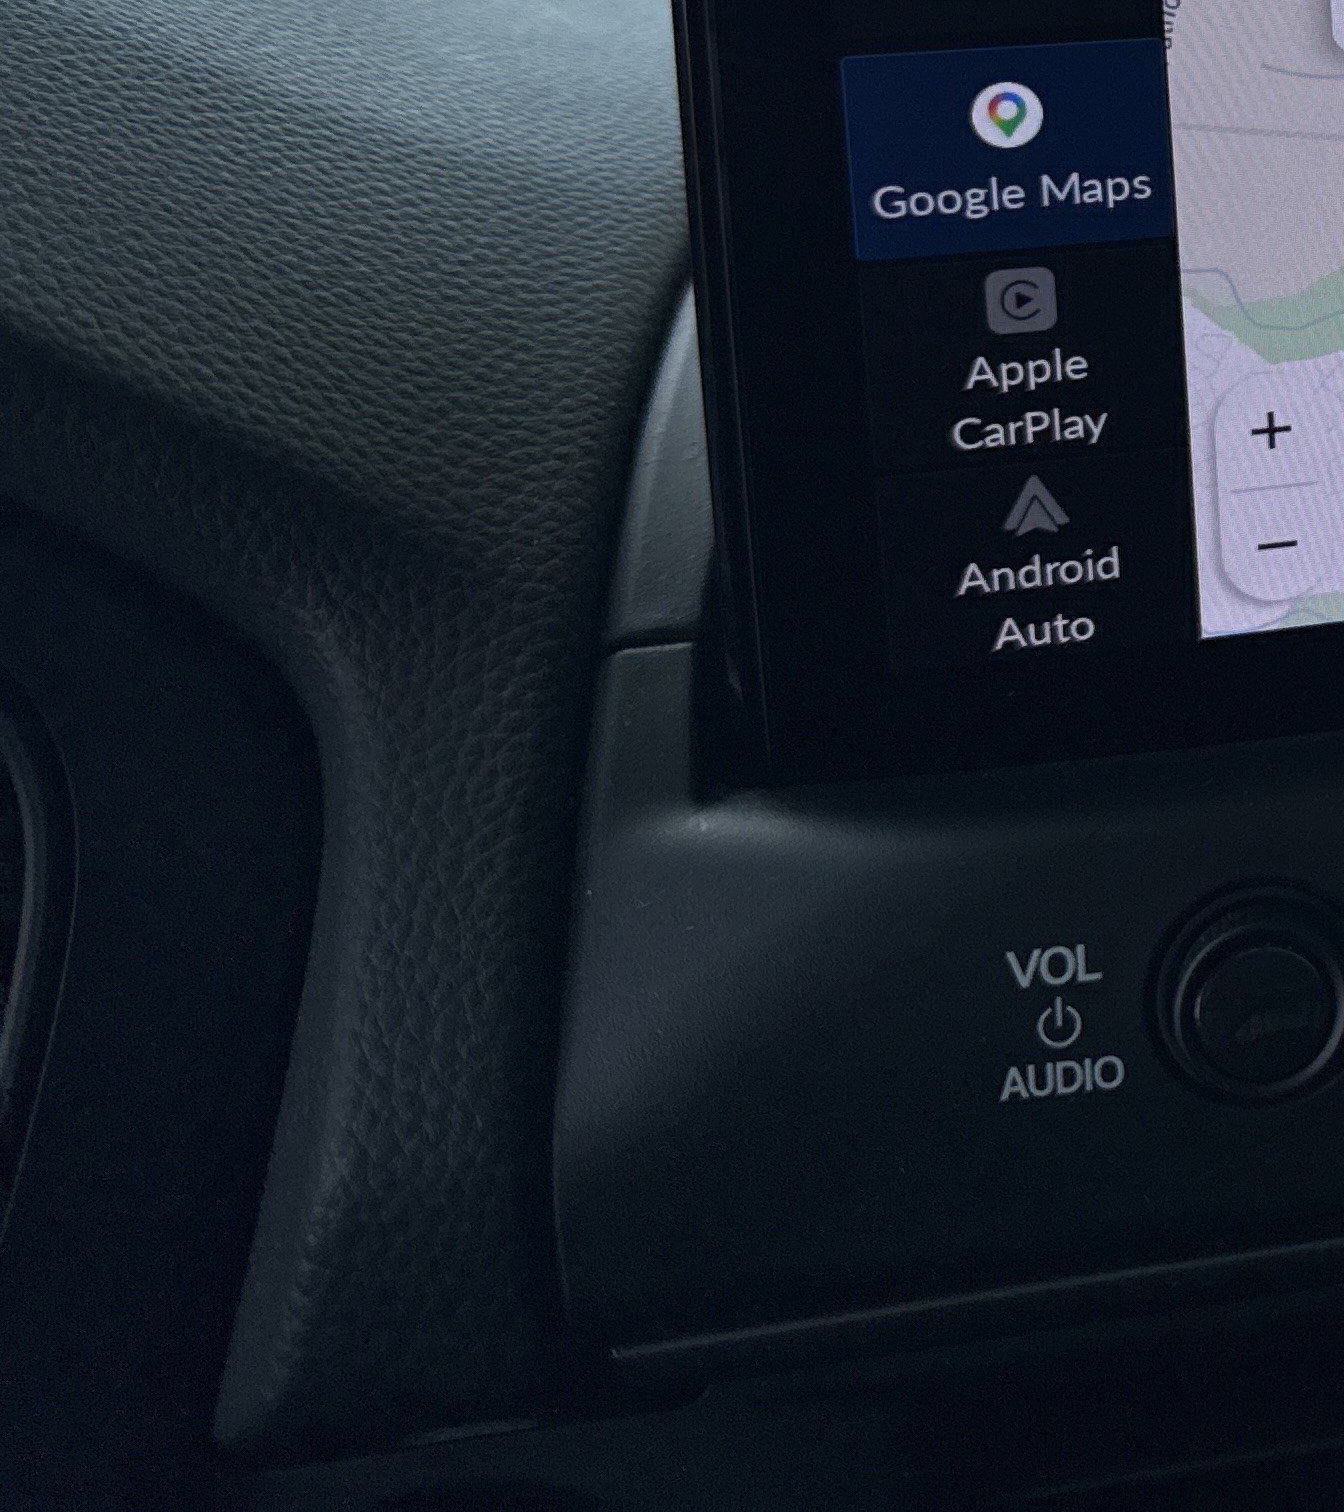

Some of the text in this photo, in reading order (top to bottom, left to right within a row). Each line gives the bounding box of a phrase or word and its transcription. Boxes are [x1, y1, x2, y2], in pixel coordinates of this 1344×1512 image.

[873, 170, 1152, 221] Google Maps
[965, 348, 1089, 392] Apple
[952, 409, 1108, 450] CarPlay
[956, 546, 1120, 598] Android
[991, 614, 1094, 652] Auto
[1006, 944, 1102, 990] VOL
[1000, 1055, 1125, 1102] AUDIO
